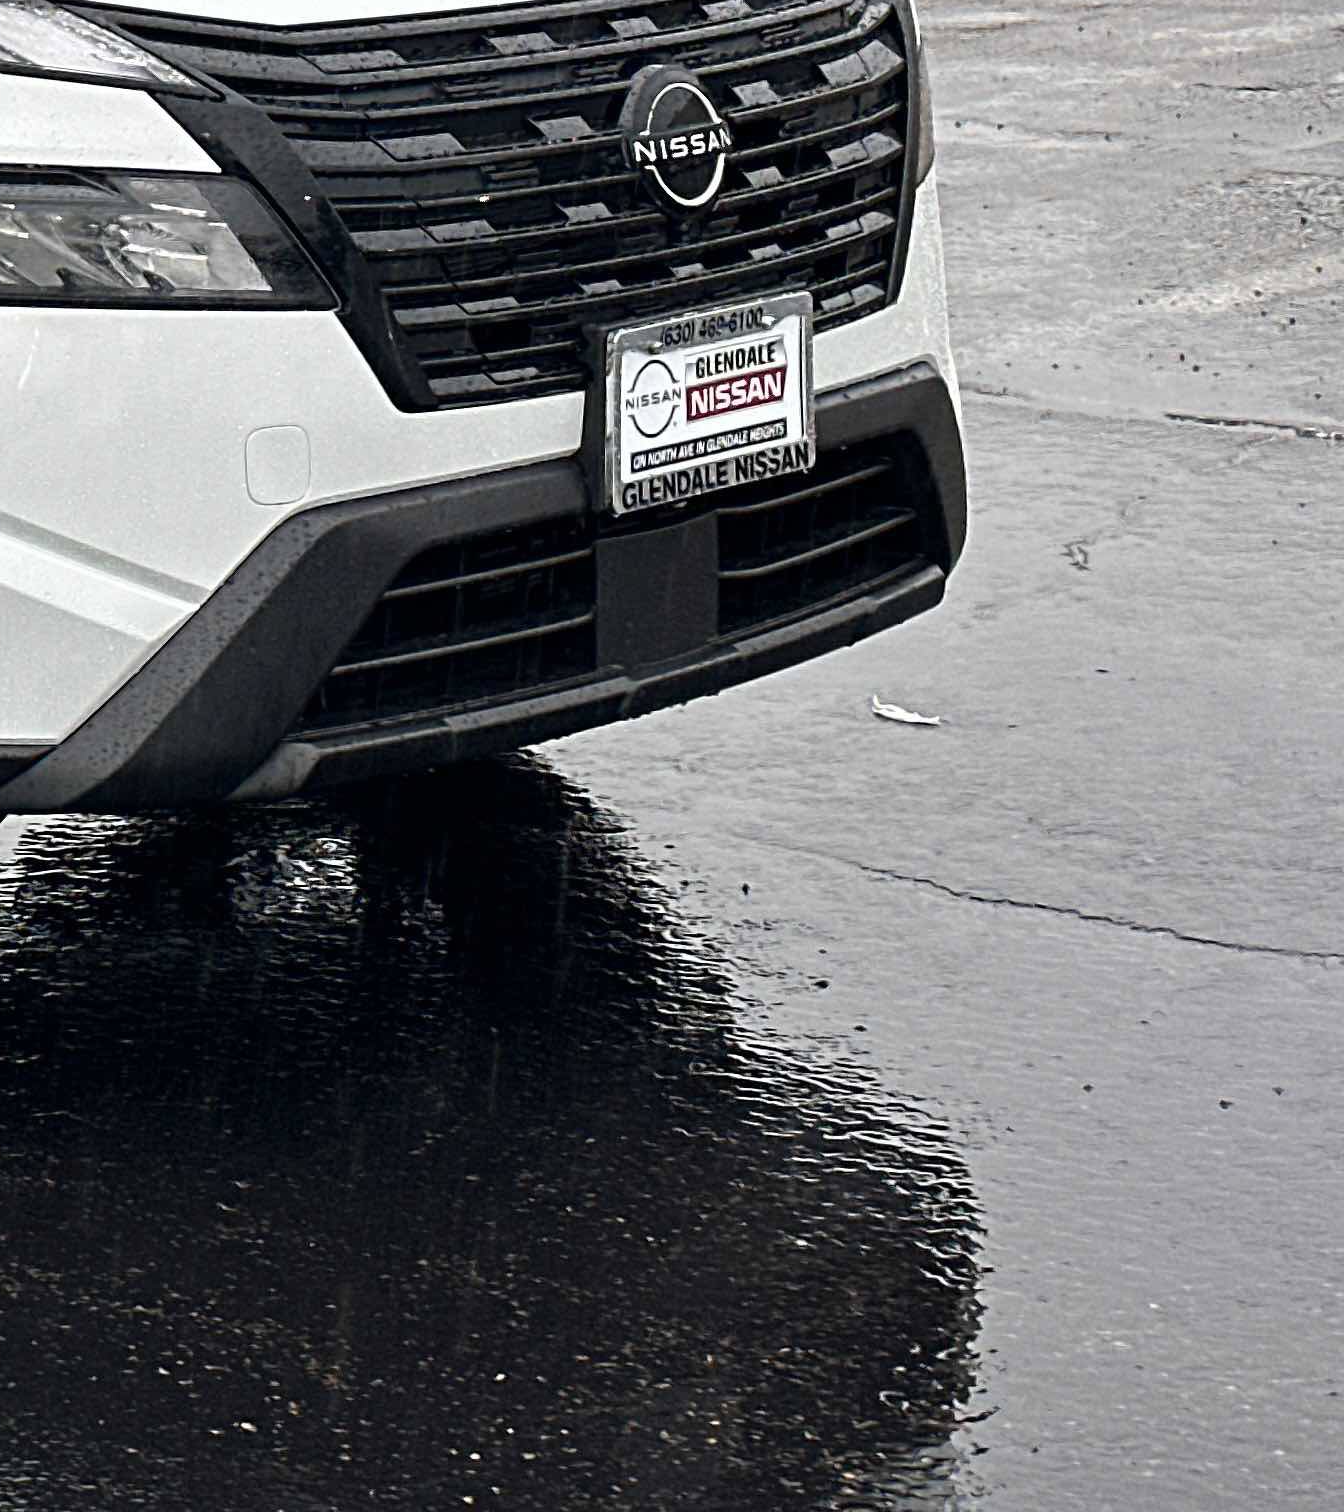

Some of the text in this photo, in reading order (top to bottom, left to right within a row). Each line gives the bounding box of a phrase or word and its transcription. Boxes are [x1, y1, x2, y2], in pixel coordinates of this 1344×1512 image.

[633, 127, 732, 162] NISSAN
[695, 340, 778, 379] GLENDALE
[625, 388, 682, 411] NISSAN
[690, 371, 782, 417] NISSAN
[632, 452, 646, 470] ON
[648, 446, 678, 466] NORTH
[678, 443, 695, 460] AVE
[696, 441, 705, 454] IN
[706, 430, 749, 451] GLENDALE
[622, 441, 810, 510] GLENDALE NISSAN
